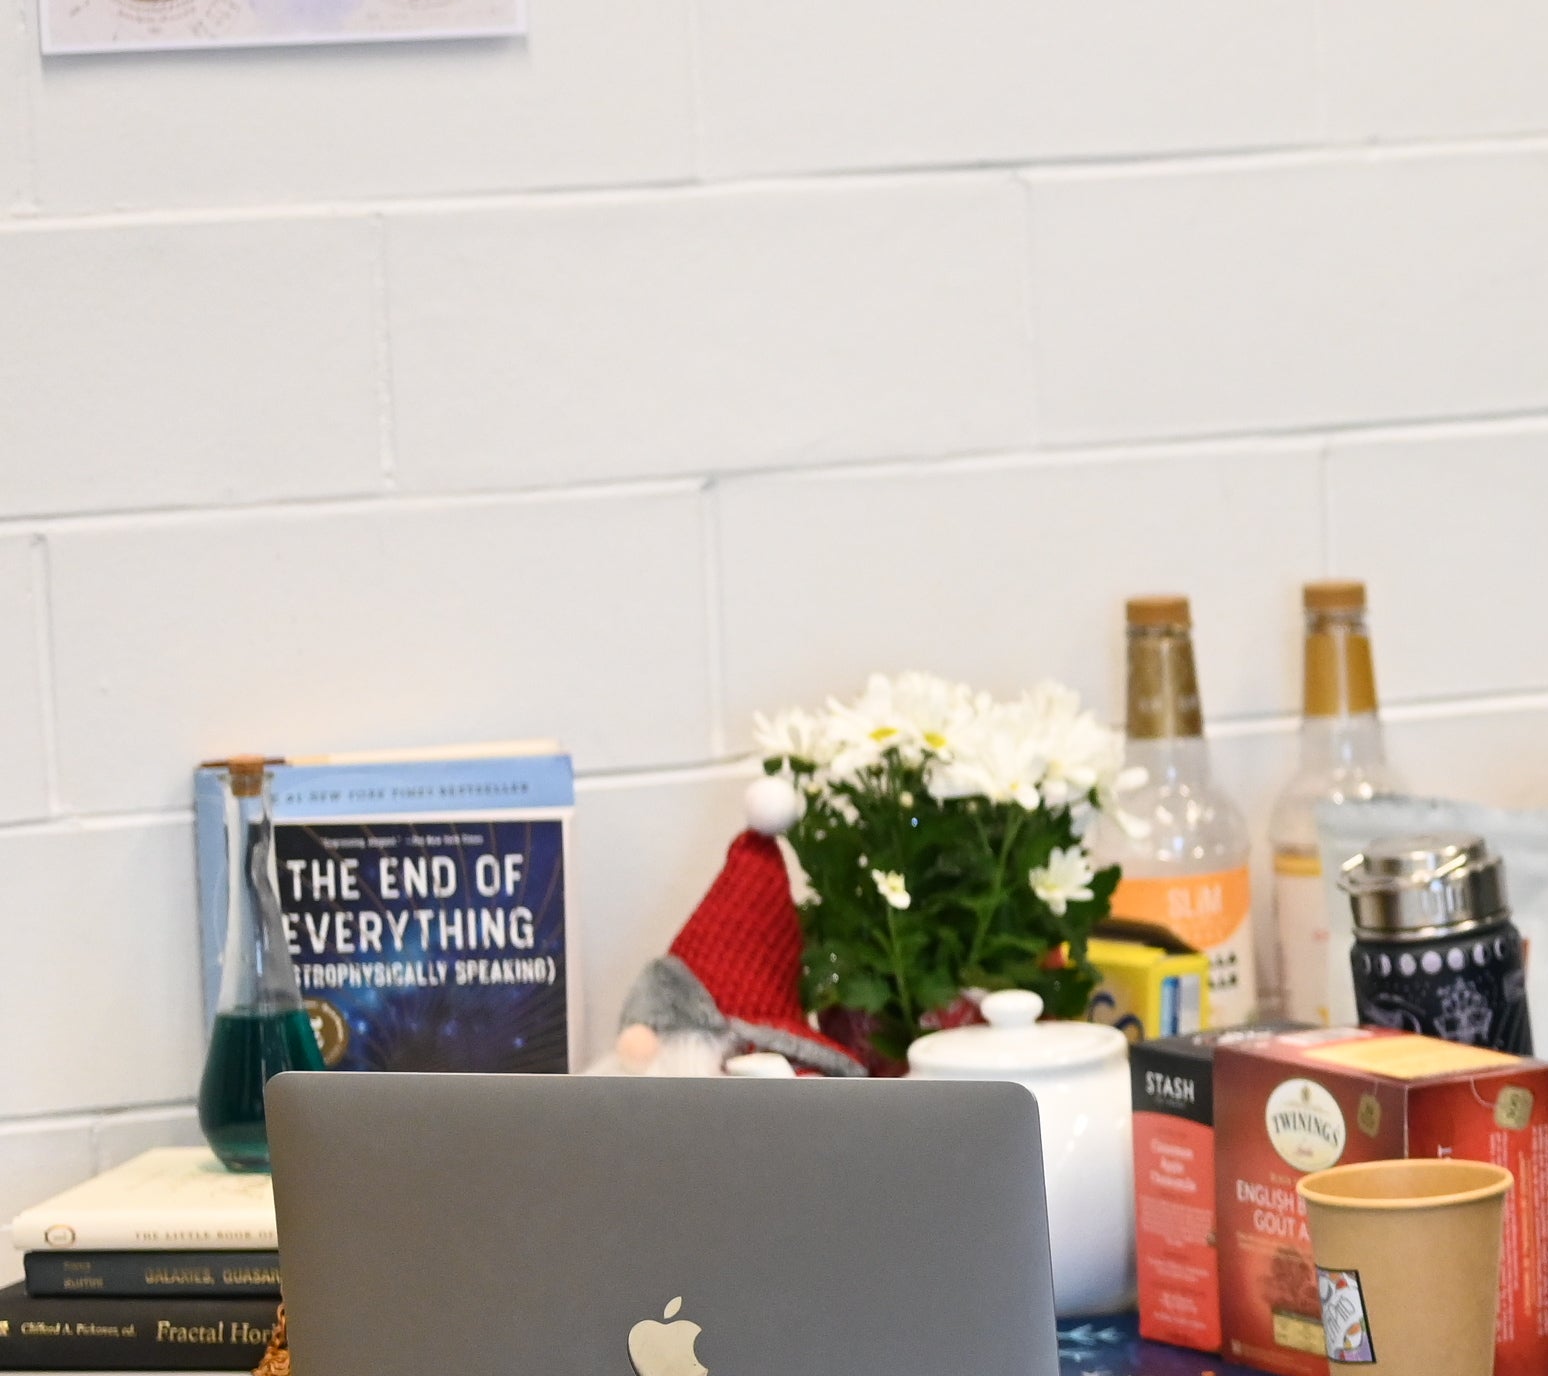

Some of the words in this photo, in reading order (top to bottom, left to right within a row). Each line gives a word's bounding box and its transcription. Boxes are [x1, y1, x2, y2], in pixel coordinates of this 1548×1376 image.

[286, 858, 361, 901] THE
[380, 855, 457, 900] END
[476, 853, 524, 898] OF
[281, 906, 535, 954] EVERYTHING
[454, 956, 556, 987] SPEAKING)
[1145, 1070, 1195, 1103] STASH
[1236, 1179, 1298, 1215] ENGLISH
[136, 1231, 159, 1240] THE
[165, 1231, 210, 1240] LITTLE
[156, 1319, 225, 1344] Fractal
